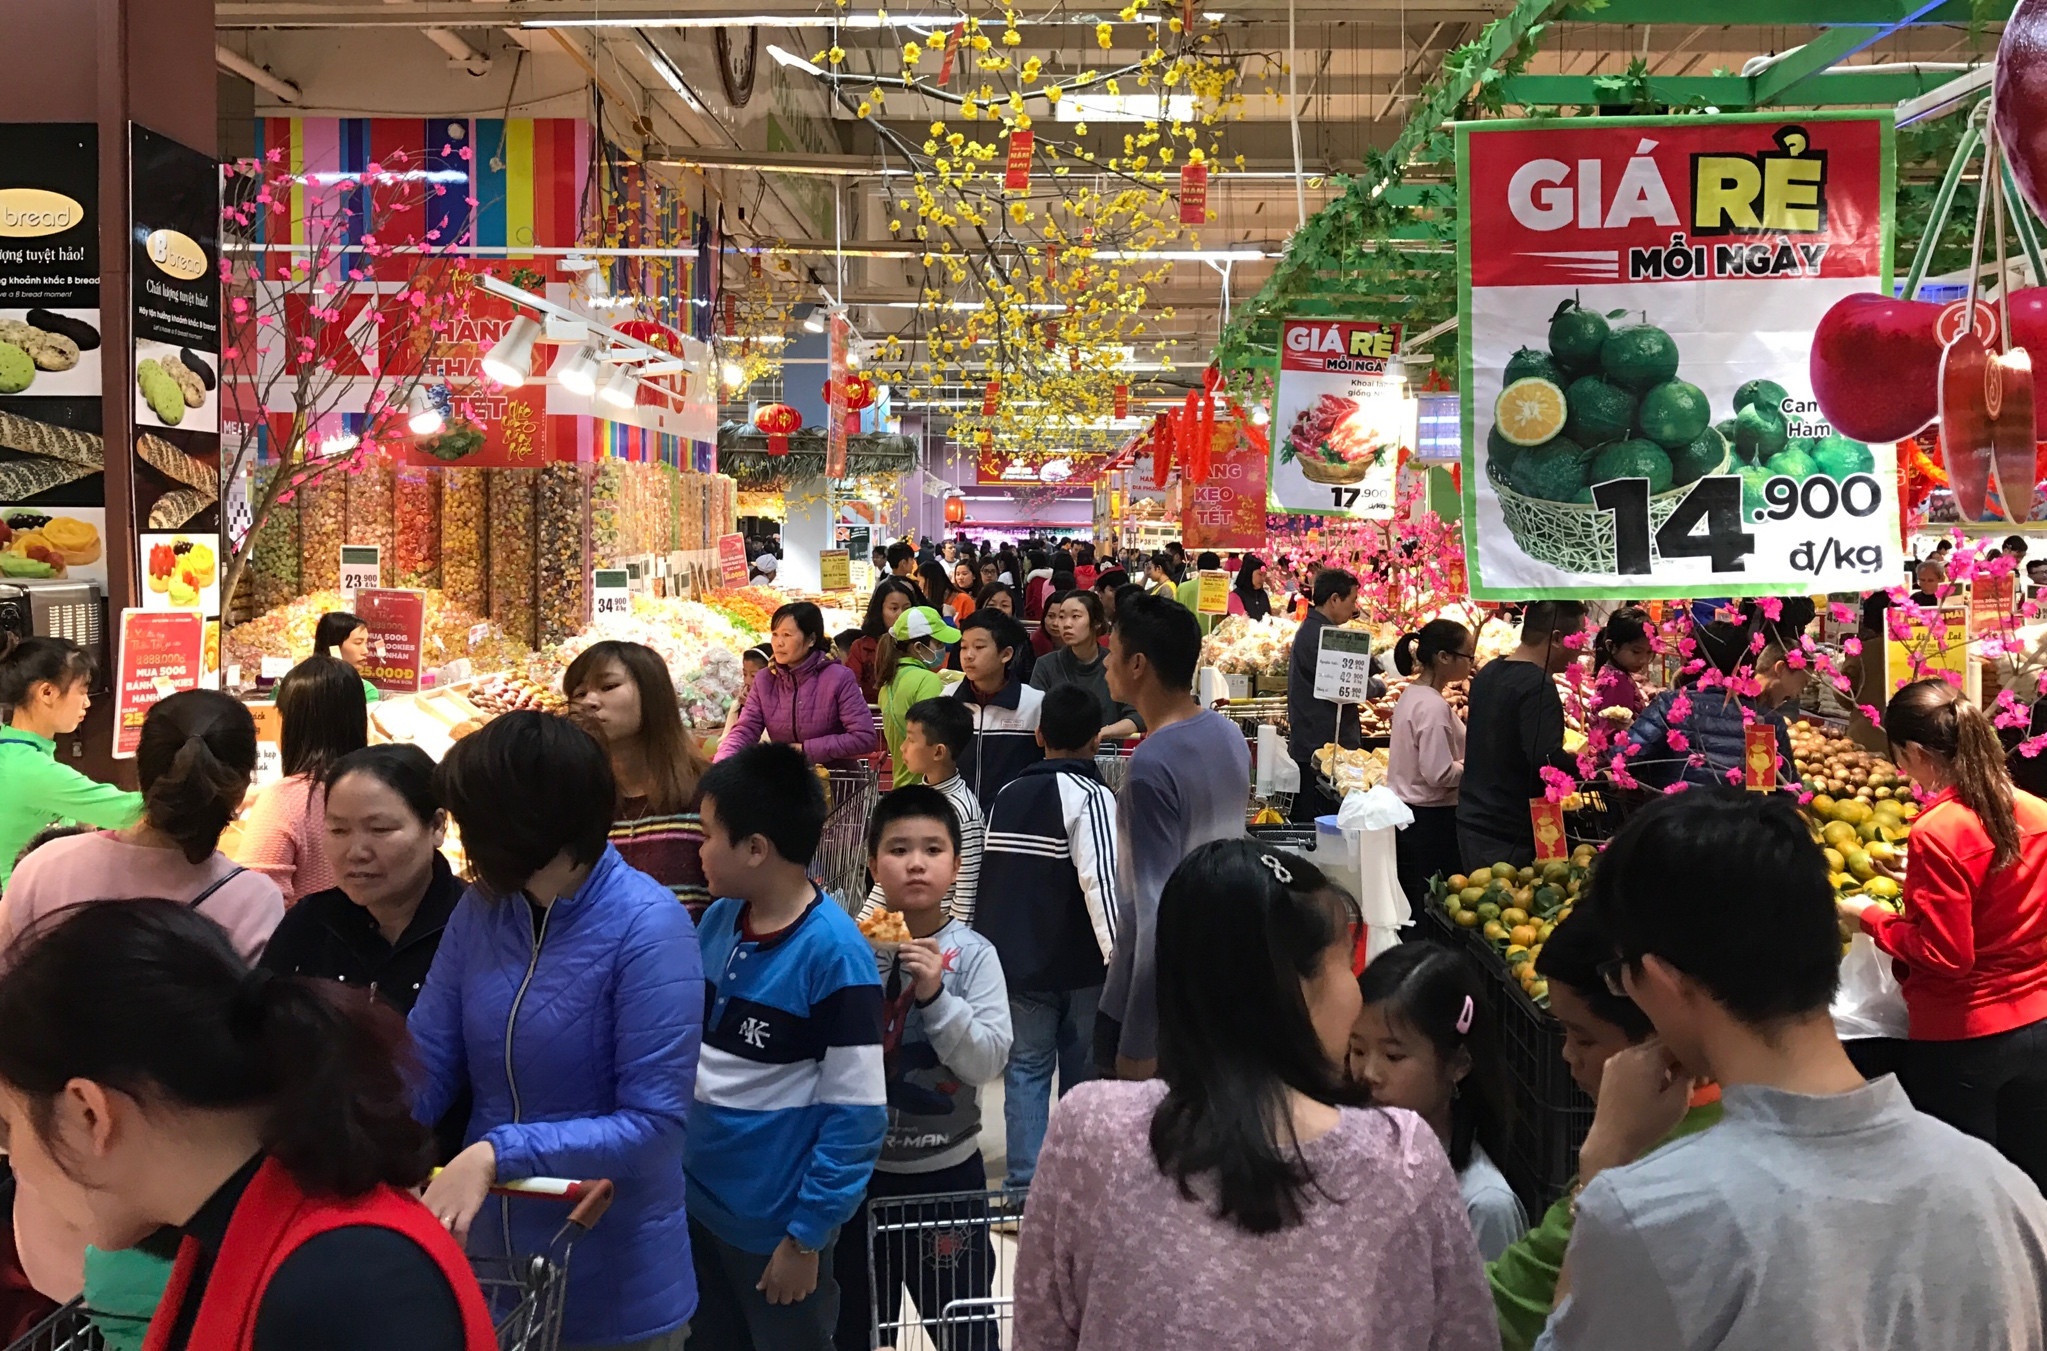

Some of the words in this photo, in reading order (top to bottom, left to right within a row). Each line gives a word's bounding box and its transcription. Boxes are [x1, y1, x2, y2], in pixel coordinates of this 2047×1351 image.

[1507, 137, 1682, 232] GIÁ
[1693, 131, 1824, 233] RẺ
[5, 206, 71, 227] bread
[26, 247, 56, 264] tuyệt
[59, 246, 85, 261] hảo!
[154, 231, 167, 264] B
[170, 248, 202, 275] bread
[1630, 233, 1706, 279] MỖI
[1715, 236, 1829, 277] NGÀY
[67, 276, 73, 285] B
[74, 276, 101, 285] bread
[1286, 323, 1345, 354] GIÁ
[1349, 325, 1395, 360] RẺ
[1326, 355, 1353, 370] MỖI
[1354, 359, 1386, 373] NGÀ
[1350, 379, 1375, 388] Khoai
[1788, 420, 1831, 437] Hàm
[1193, 486, 1235, 505] KẸO
[1195, 505, 1233, 526] TẾT
[1788, 536, 1884, 575] đ/kg
[384, 633, 408, 642] 500G
[136, 668, 158, 678] MUA
[159, 665, 187, 676] 500G
